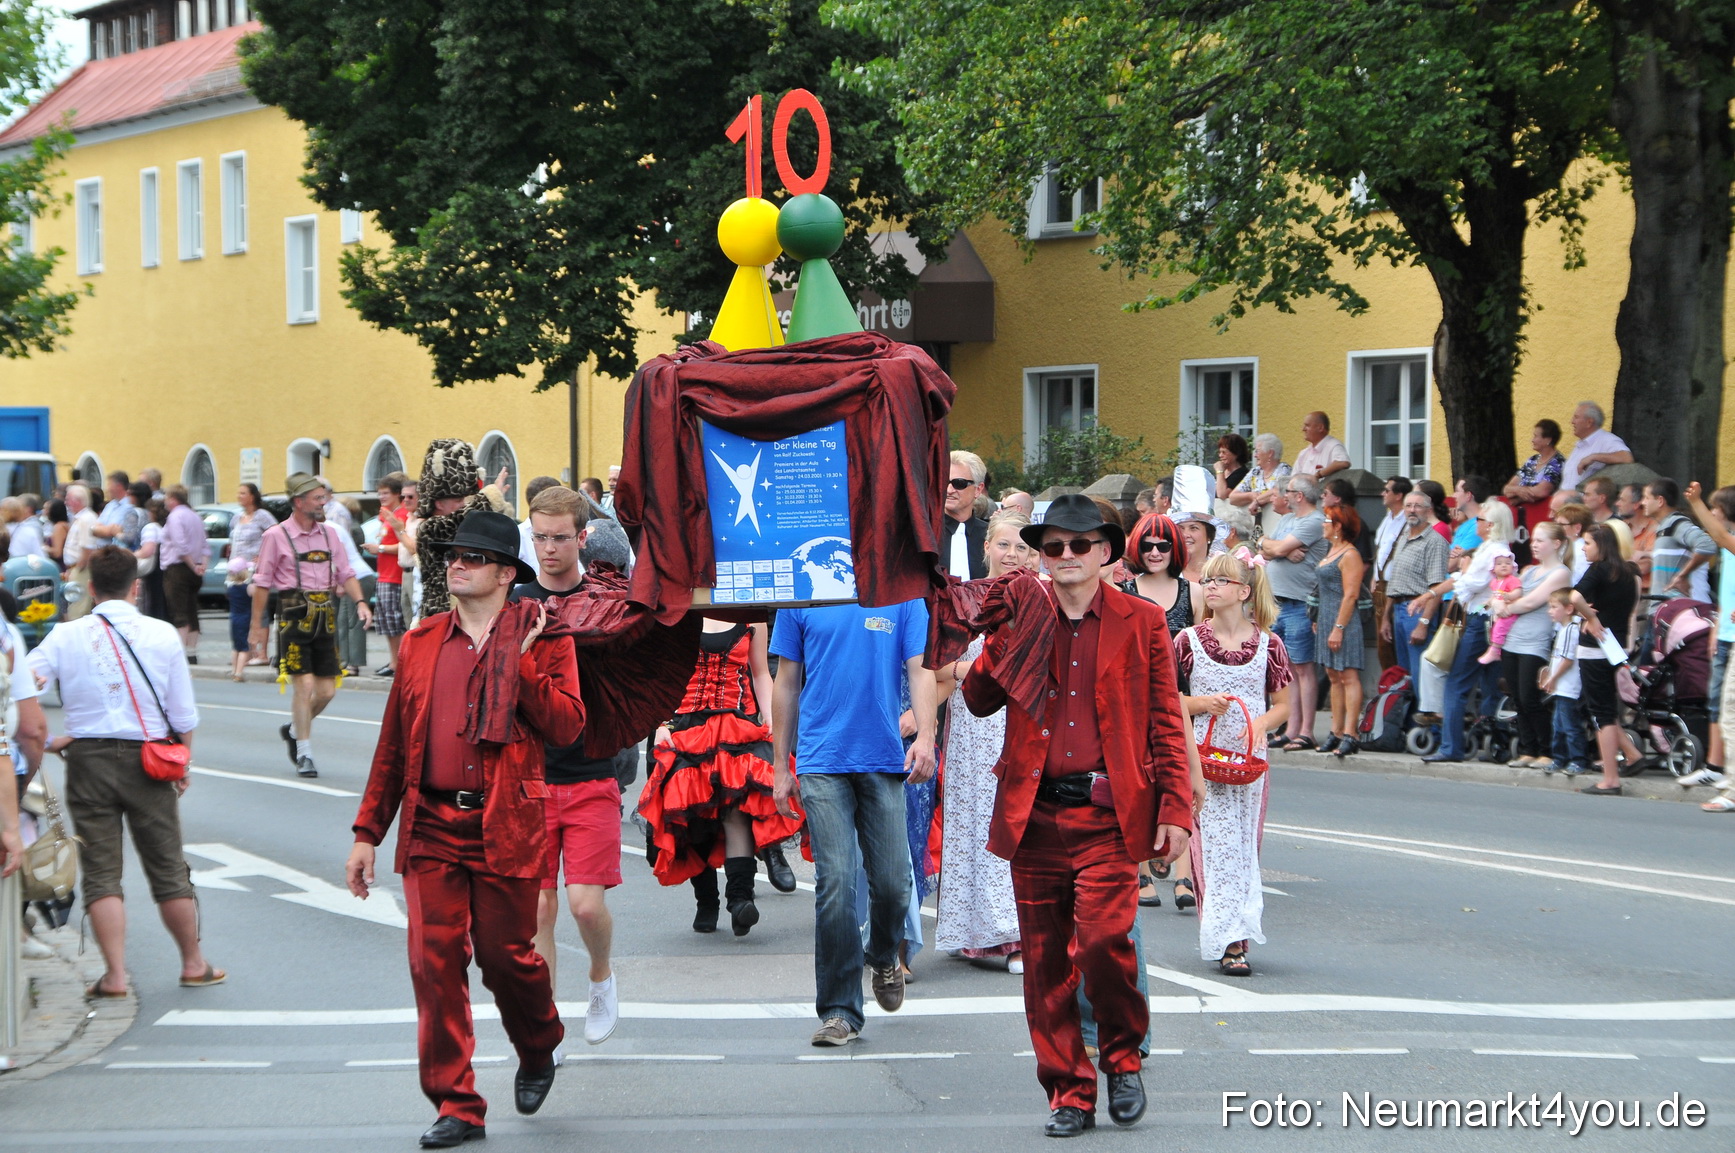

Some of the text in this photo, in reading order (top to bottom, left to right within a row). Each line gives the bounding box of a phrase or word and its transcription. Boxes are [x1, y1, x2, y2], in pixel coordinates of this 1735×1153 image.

[725, 88, 831, 199] 10
[774, 440, 836, 450] Der kleine Tag
